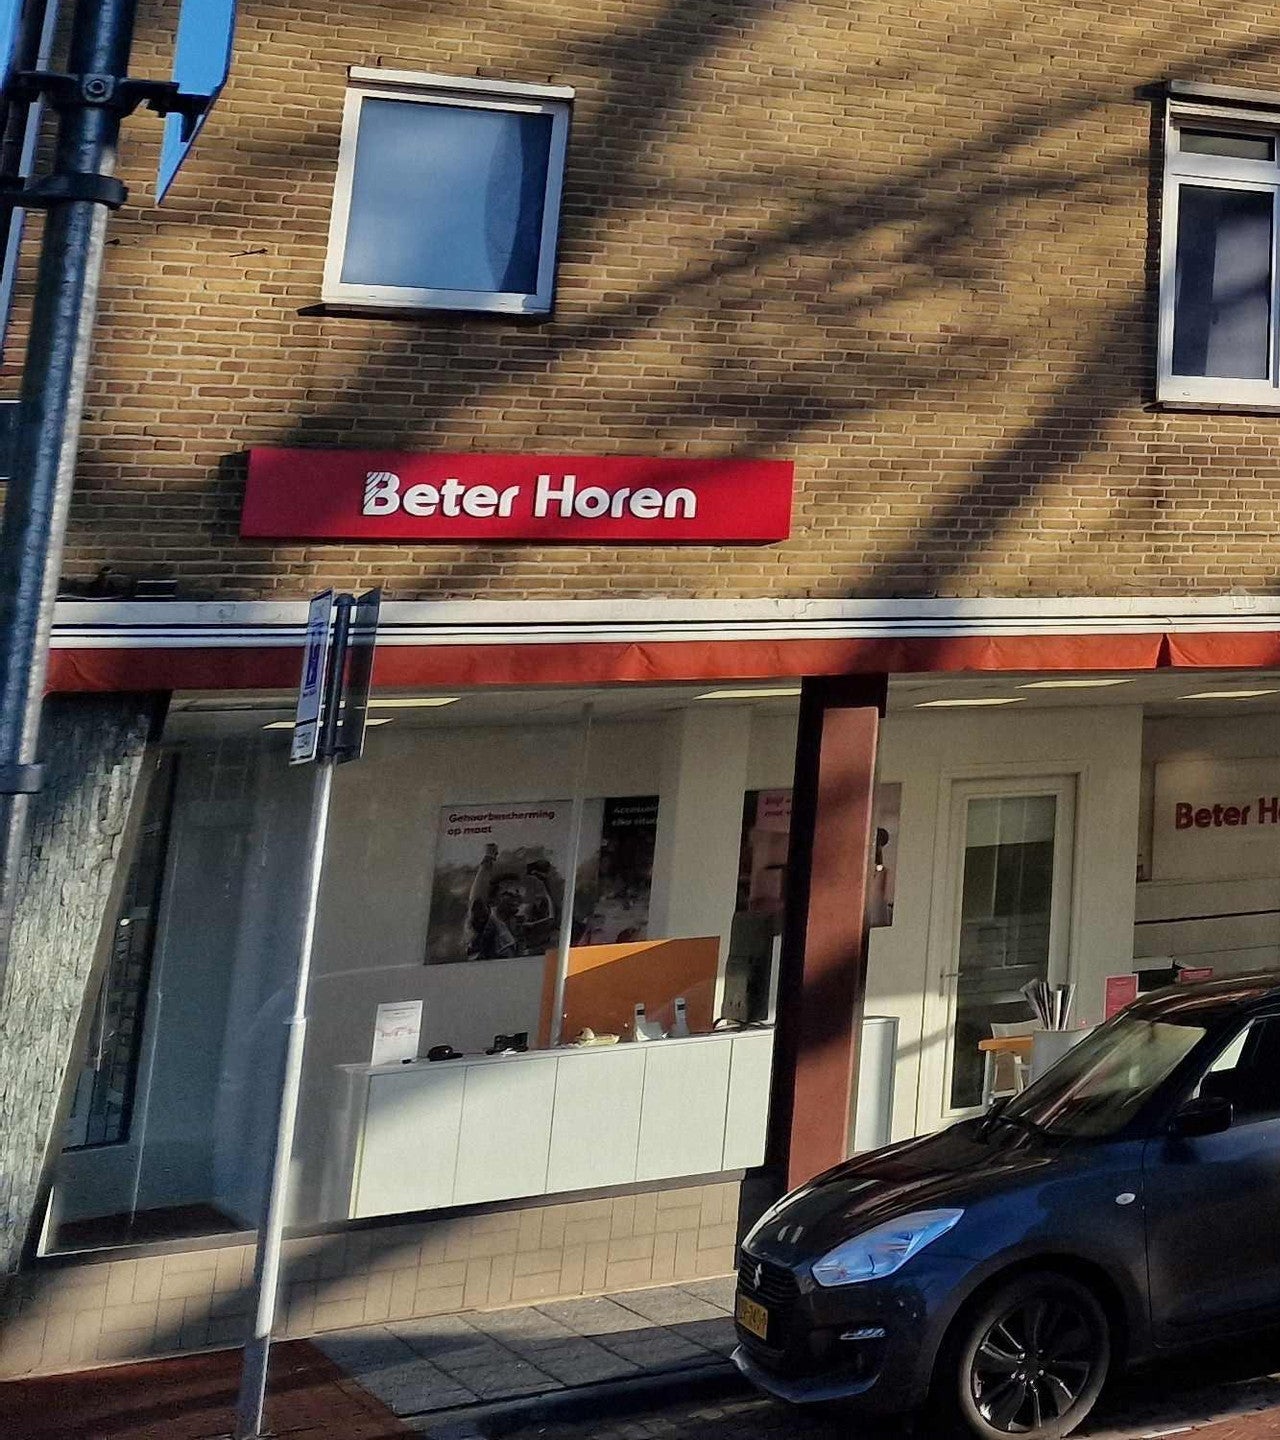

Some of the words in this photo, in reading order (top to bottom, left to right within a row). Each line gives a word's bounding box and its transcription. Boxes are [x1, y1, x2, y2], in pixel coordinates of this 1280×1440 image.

[362, 471, 520, 517] Beter
[534, 474, 697, 519] Horen
[448, 810, 555, 824] Gehoorbescherming
[1175, 802, 1250, 830] Beter
[447, 827, 462, 836] op
[464, 825, 493, 835] maat
